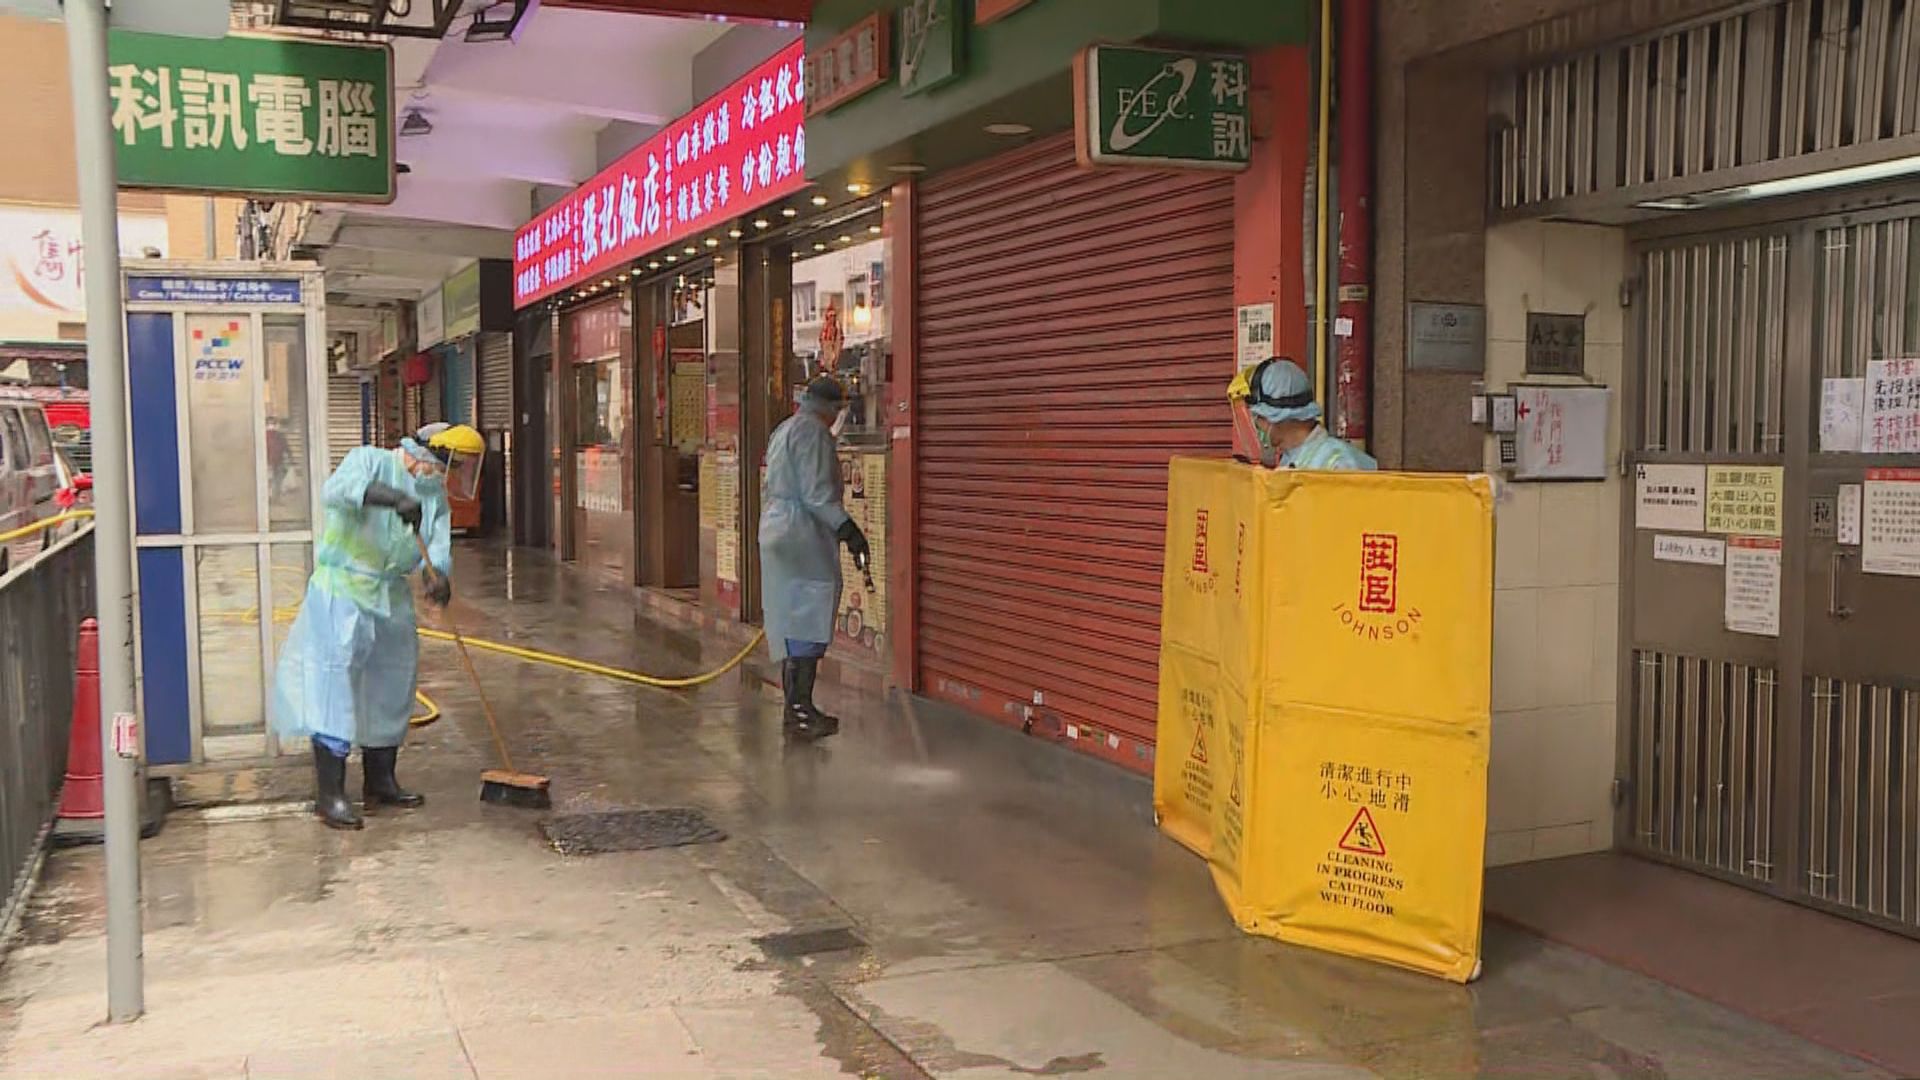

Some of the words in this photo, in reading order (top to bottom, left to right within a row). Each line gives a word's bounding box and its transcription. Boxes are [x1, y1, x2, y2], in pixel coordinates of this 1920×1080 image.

[110, 64, 378, 158] 科訊電腦
[1211, 60, 1247, 157] 科訊
[195, 359, 244, 370] PCCW
[1331, 602, 1422, 641] JOHNSON
[1320, 761, 1412, 791] 清潔進行中
[1320, 780, 1411, 813] 小心地滑
[1316, 863, 1331, 875] IN
[1334, 866, 1404, 890] PROGRESS
[1327, 851, 1393, 874] CLEANING
[1320, 891, 1351, 906] WET
[1352, 897, 1395, 916] FLOOR
[1328, 880, 1386, 900] CAUTION
